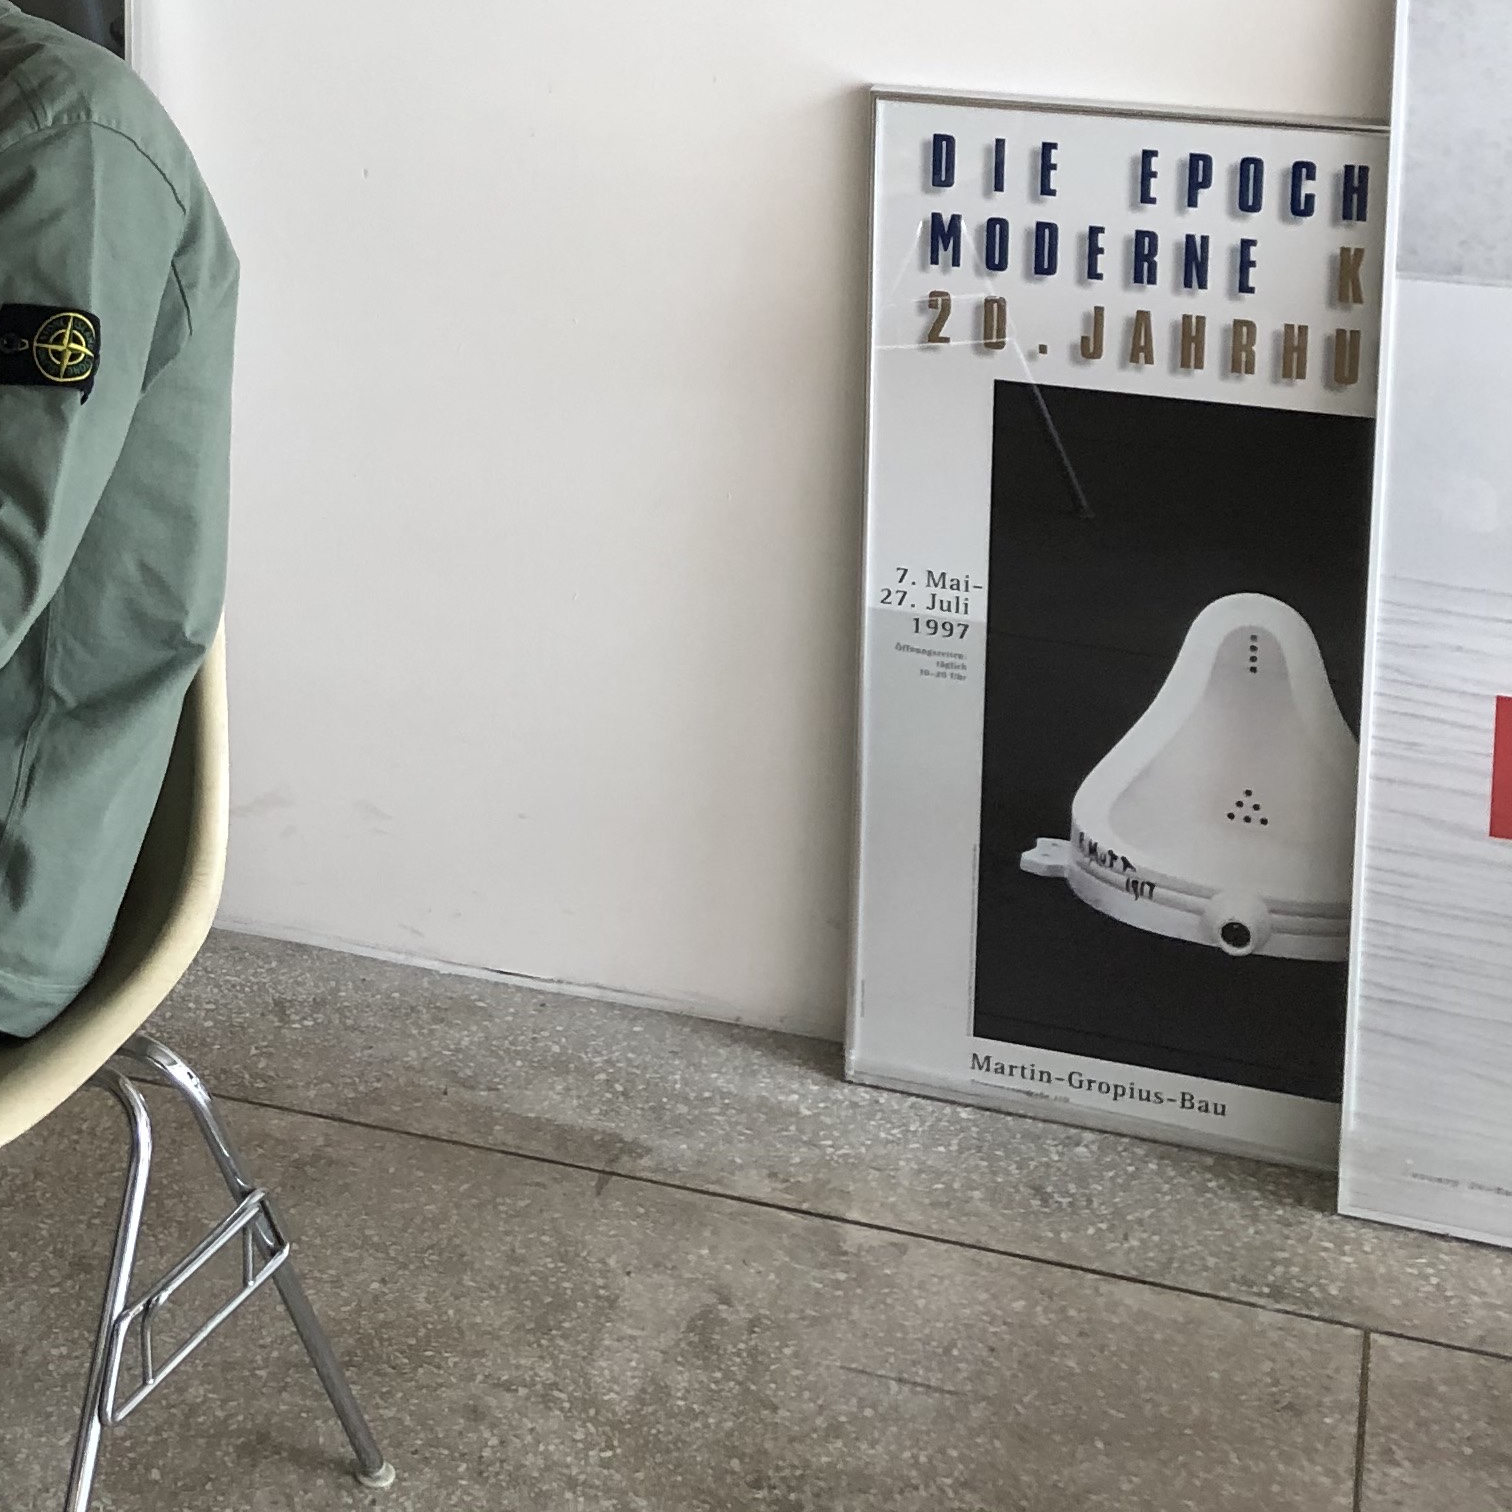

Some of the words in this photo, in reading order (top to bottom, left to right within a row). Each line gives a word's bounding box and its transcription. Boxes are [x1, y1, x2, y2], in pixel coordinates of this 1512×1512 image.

[931, 133, 1059, 197] DIE
[1139, 148, 1370, 223] EPOCH
[929, 211, 1258, 294] MODERNE
[927, 290, 1048, 356] 20.
[1079, 305, 1361, 385] JAHRHU
[879, 587, 916, 609] 27.
[925, 592, 970, 615] Juli
[895, 566, 917, 586] 7.
[912, 617, 970, 640] 1997
[970, 1052, 1227, 1117] Martin-Gropius-Bau
